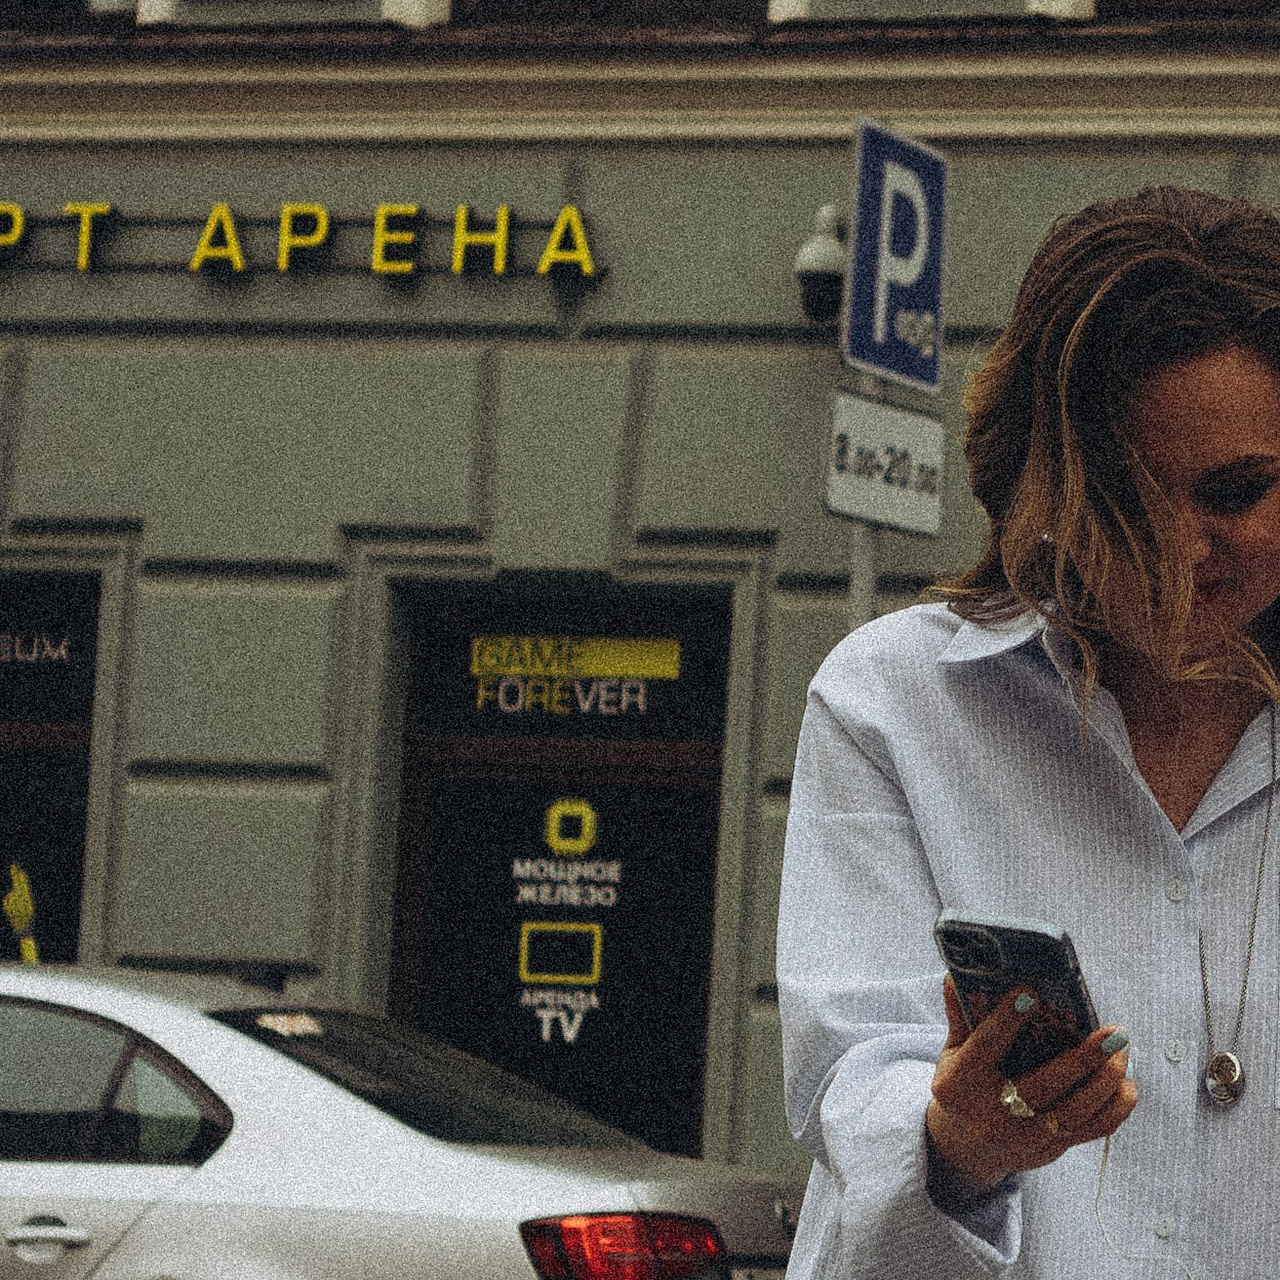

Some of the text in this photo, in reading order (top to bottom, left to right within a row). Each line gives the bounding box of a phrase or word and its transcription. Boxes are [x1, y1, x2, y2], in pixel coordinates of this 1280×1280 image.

[189, 202, 595, 276] АРЕНА
[477, 637, 585, 672] GAME
[475, 677, 648, 715] FOREVER
[515, 883, 618, 907] ЖЕЛЕЗО
[535, 1009, 584, 1044] TV
